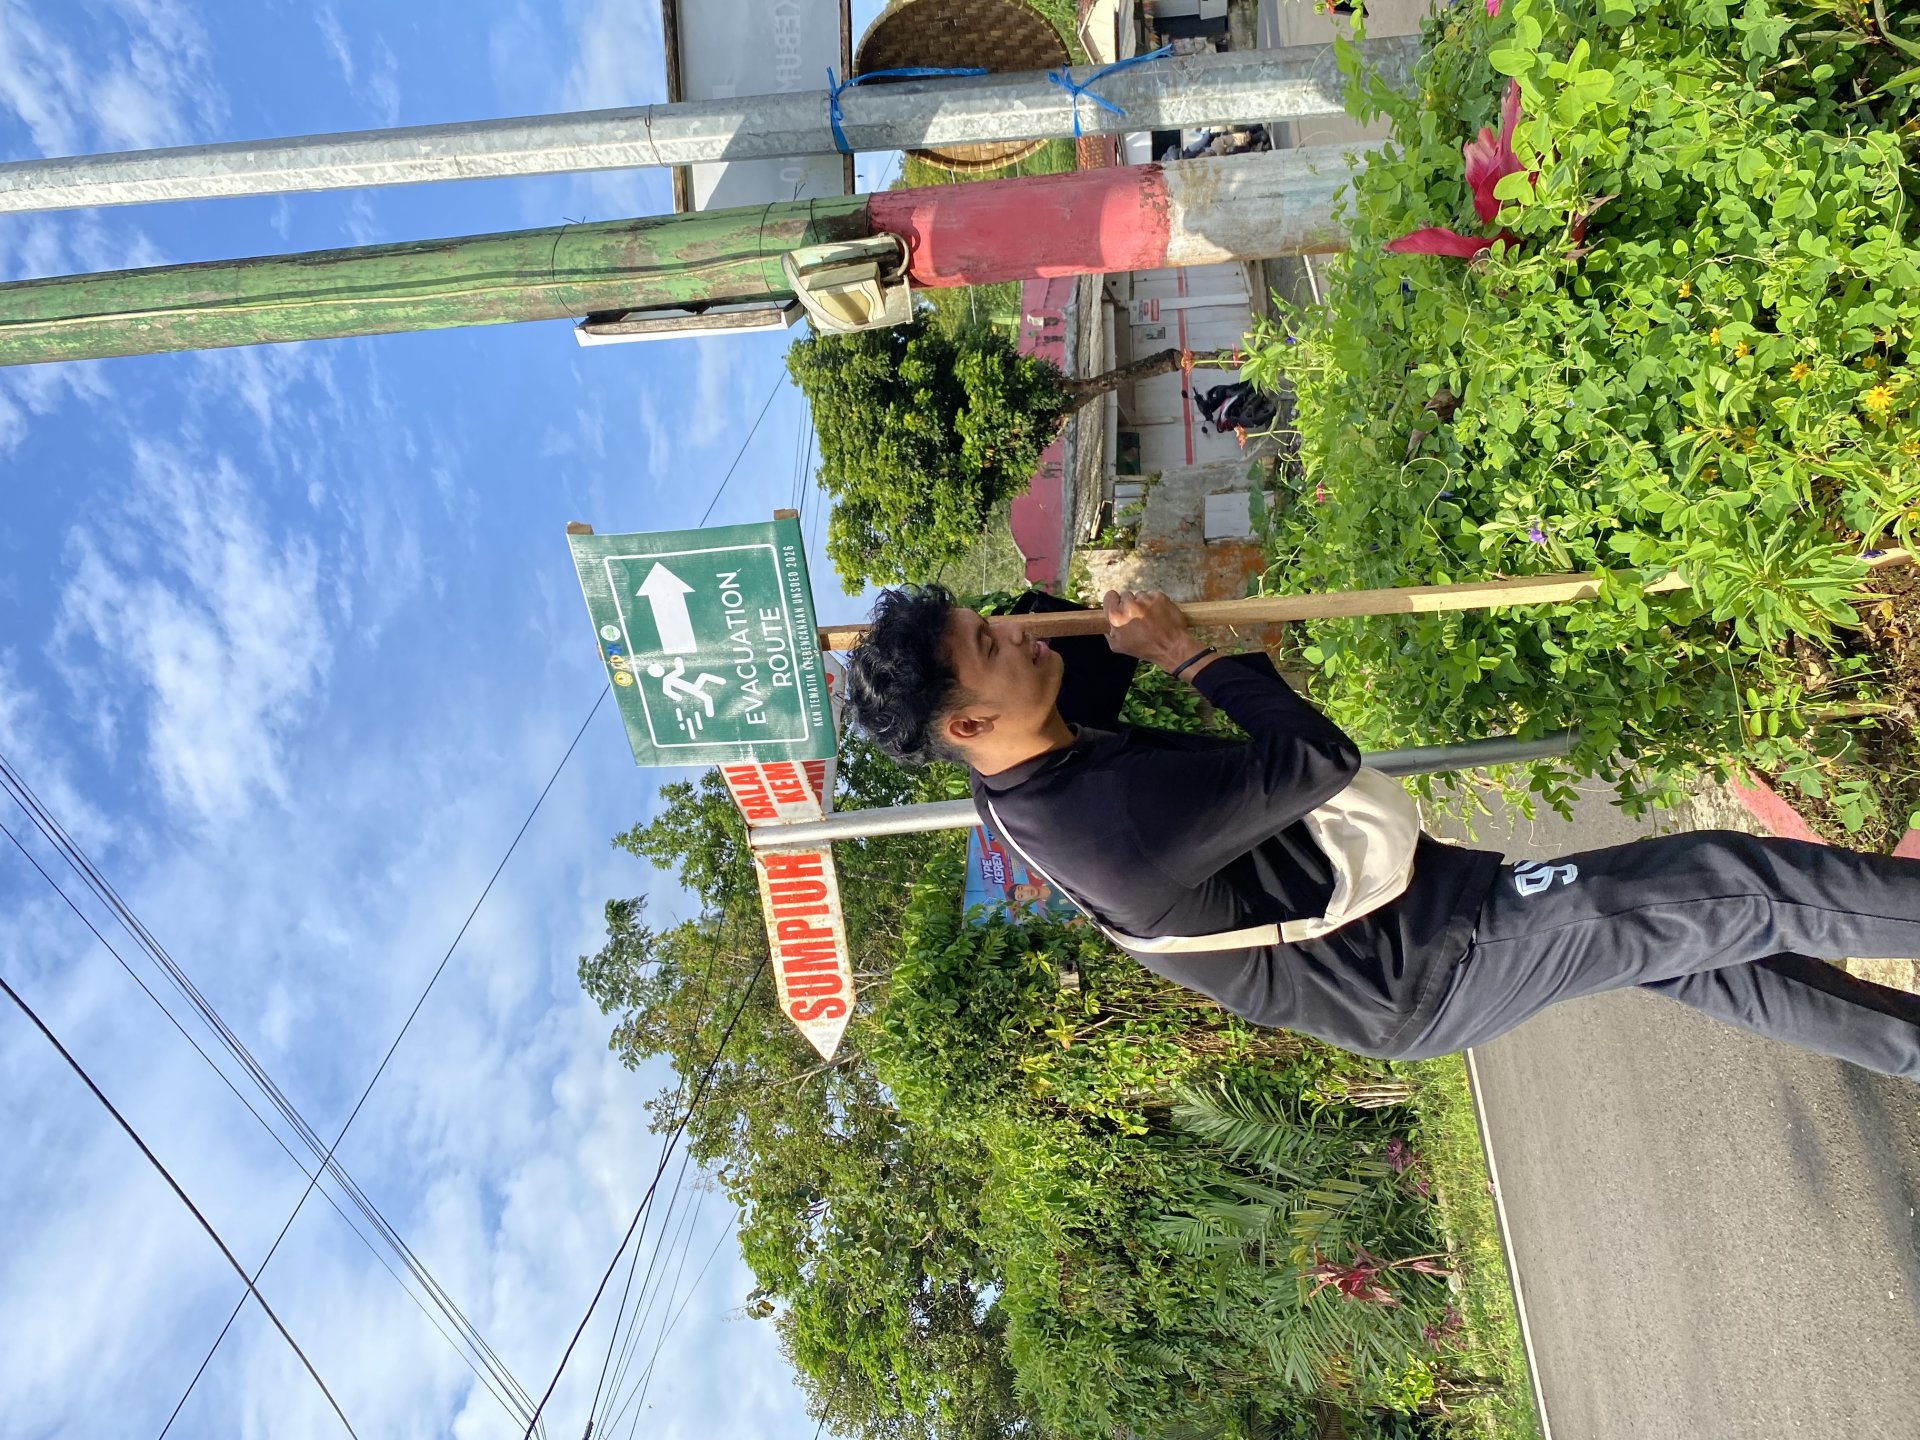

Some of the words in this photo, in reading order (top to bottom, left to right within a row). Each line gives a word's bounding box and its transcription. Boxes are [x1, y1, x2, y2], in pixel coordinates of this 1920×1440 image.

[782, 545, 797, 568] 2026
[787, 571, 803, 604] UNSOED
[716, 572, 767, 725] EVACUATION
[759, 607, 793, 687] ROUTE
[805, 673, 820, 708] TEMATIK
[813, 710, 824, 727] KKN
[725, 765, 778, 820] BALAI
[982, 859, 994, 879] YPE
[989, 851, 1005, 884] KEREN
[763, 853, 847, 1022] SUMPIUH
